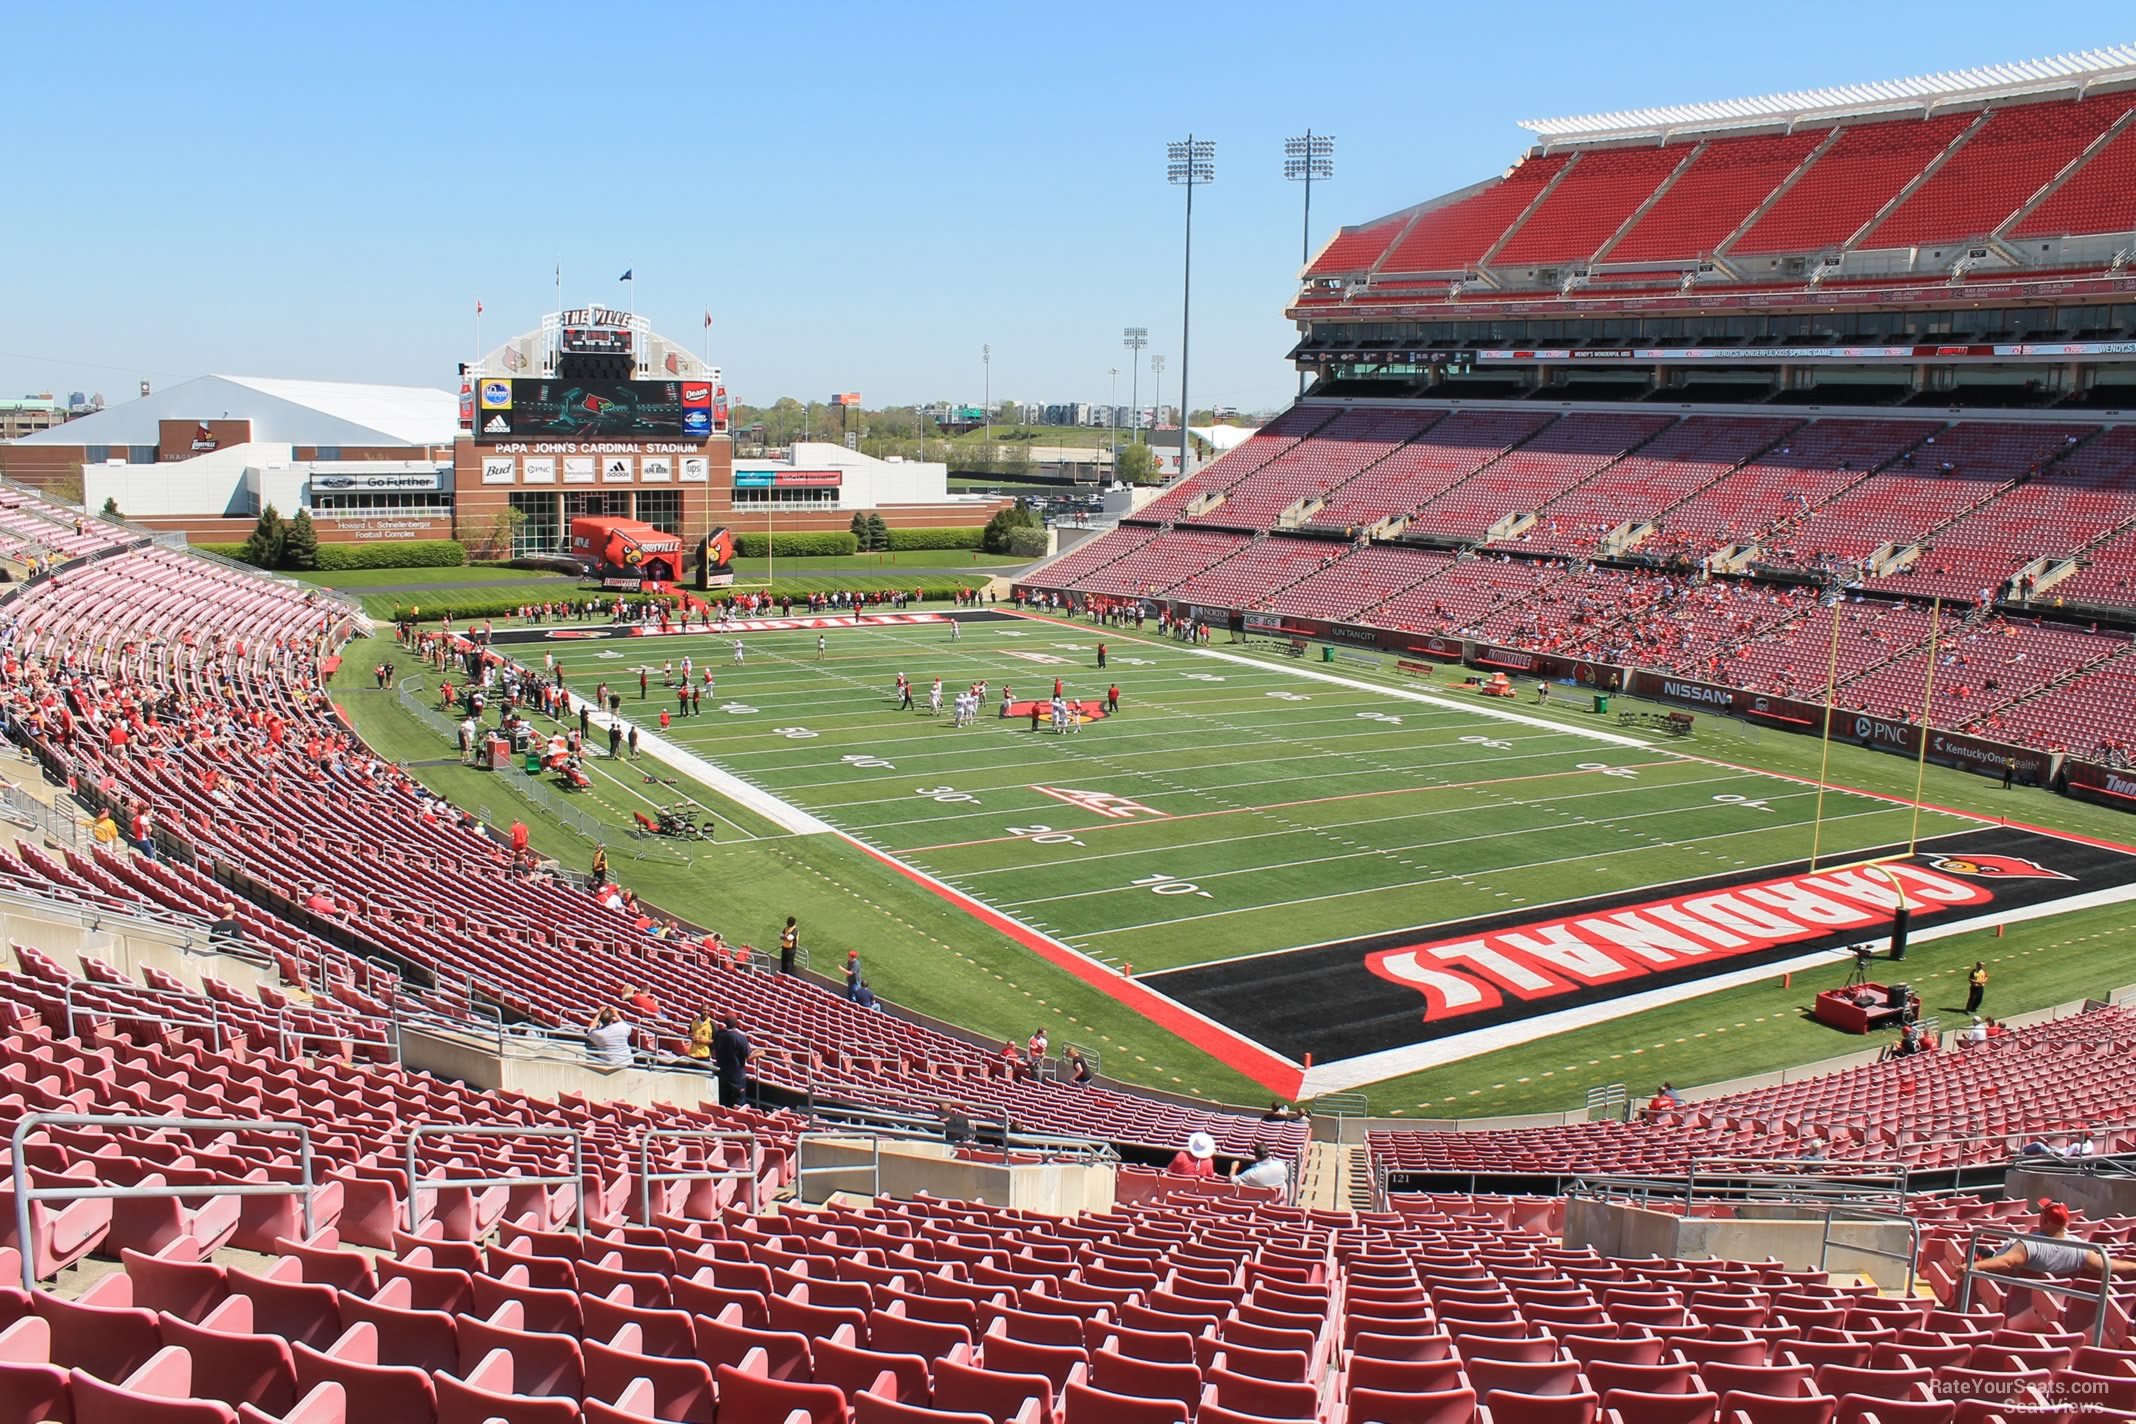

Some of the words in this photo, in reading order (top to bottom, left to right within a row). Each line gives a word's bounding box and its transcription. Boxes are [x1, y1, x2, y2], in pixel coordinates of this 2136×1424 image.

[562, 310, 589, 325] THE
[593, 309, 632, 327] VILLE
[484, 425, 511, 433] adidas
[495, 443, 528, 453] PAPA
[533, 441, 576, 453] JOHN'S
[580, 443, 642, 453] CARDINAL
[646, 443, 698, 453] STADIUM
[486, 464, 512, 476] Bud
[367, 477, 385, 487] Go
[386, 477, 430, 487] Further
[384, 530, 416, 539] Complex
[1664, 681, 1727, 704] NISSAN
[773, 727, 820, 739] 50
[1874, 722, 1908, 745] PNC
[1945, 743, 2006, 764] KentuckyOne
[840, 755, 890, 768] 40
[1575, 762, 1641, 776] 20
[915, 786, 974, 802] 30
[1712, 794, 1769, 807] 10
[1004, 824, 1075, 845] 20
[1131, 873, 1199, 896] 10
[1375, 862, 1983, 1013] CARDINALS
[1392, 1174, 1409, 1183] 121
